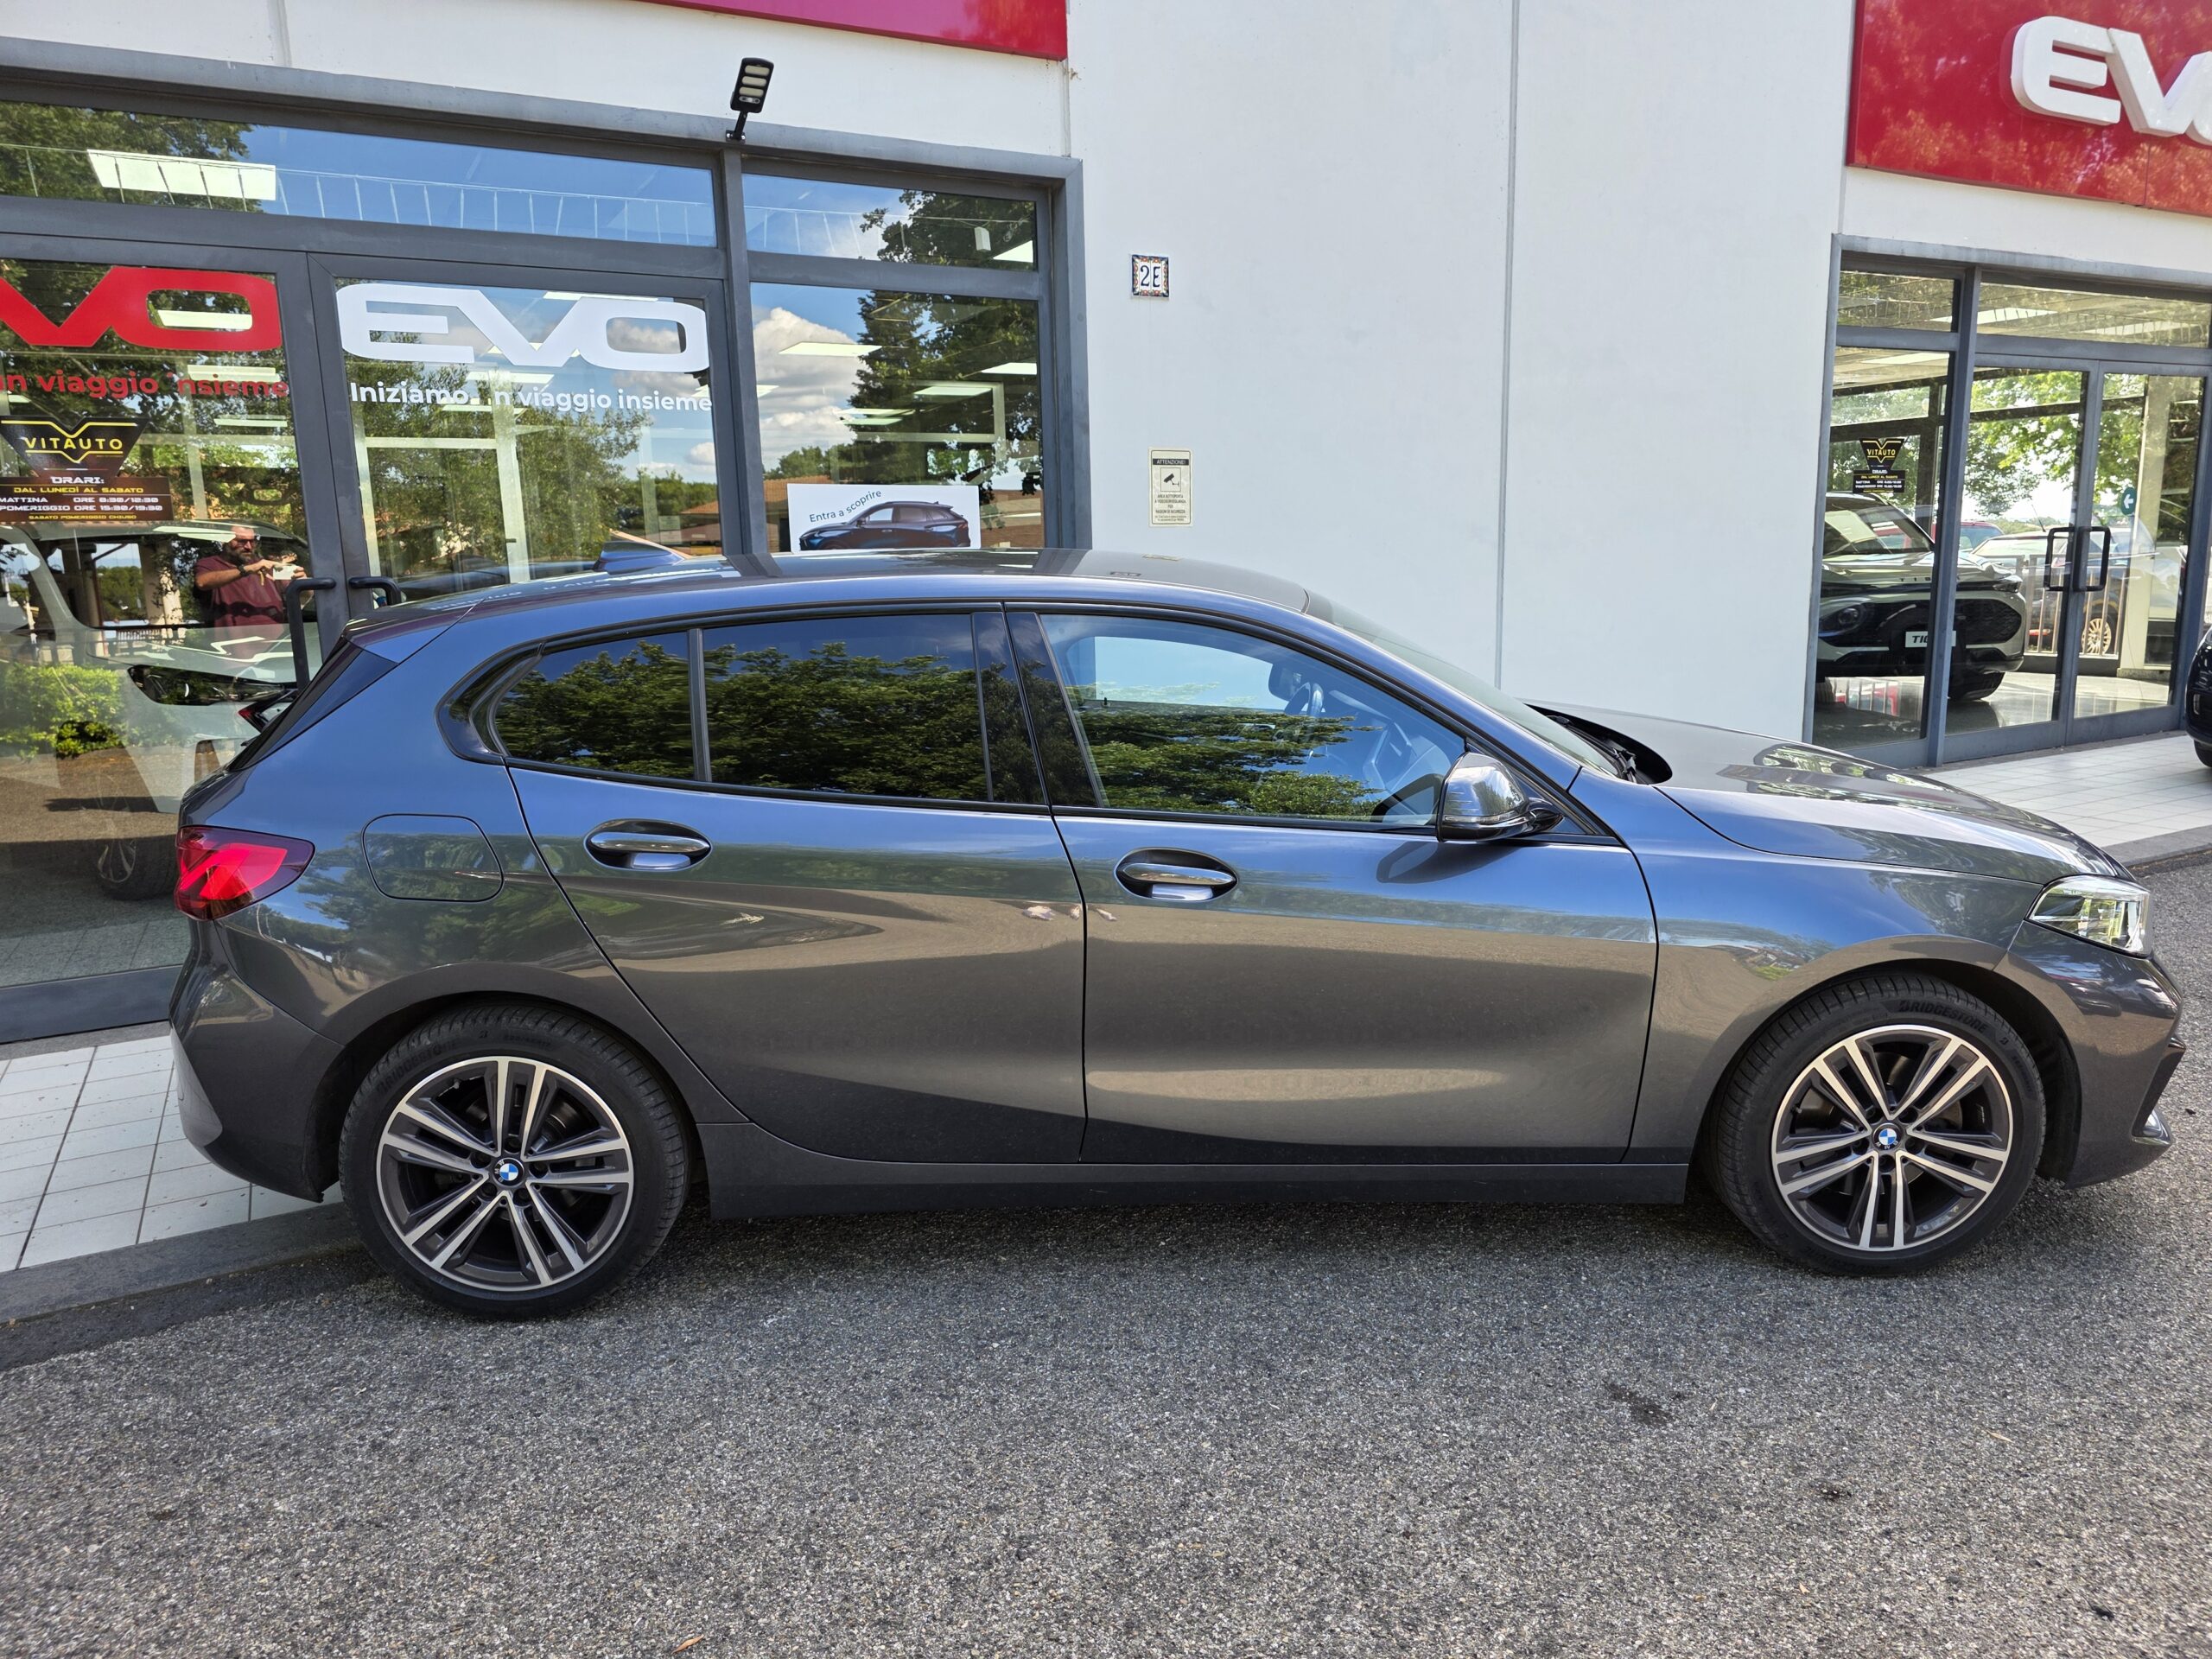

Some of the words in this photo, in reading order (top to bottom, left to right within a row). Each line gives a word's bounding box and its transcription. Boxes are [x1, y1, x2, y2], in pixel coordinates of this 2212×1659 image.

[1141, 265, 1160, 287] 2E
[336, 283, 710, 372] EVO
[36, 369, 159, 399] viaggio
[167, 371, 290, 397] nsieme
[351, 382, 469, 405] Iniziamo
[517, 386, 612, 413] viaggio
[618, 388, 713, 412] insieme
[24, 437, 123, 449] VITAUTO
[809, 512, 836, 523] Entra
[846, 491, 881, 513] scoprire
[1899, 1001, 1987, 1033] BRIDGESTONE
